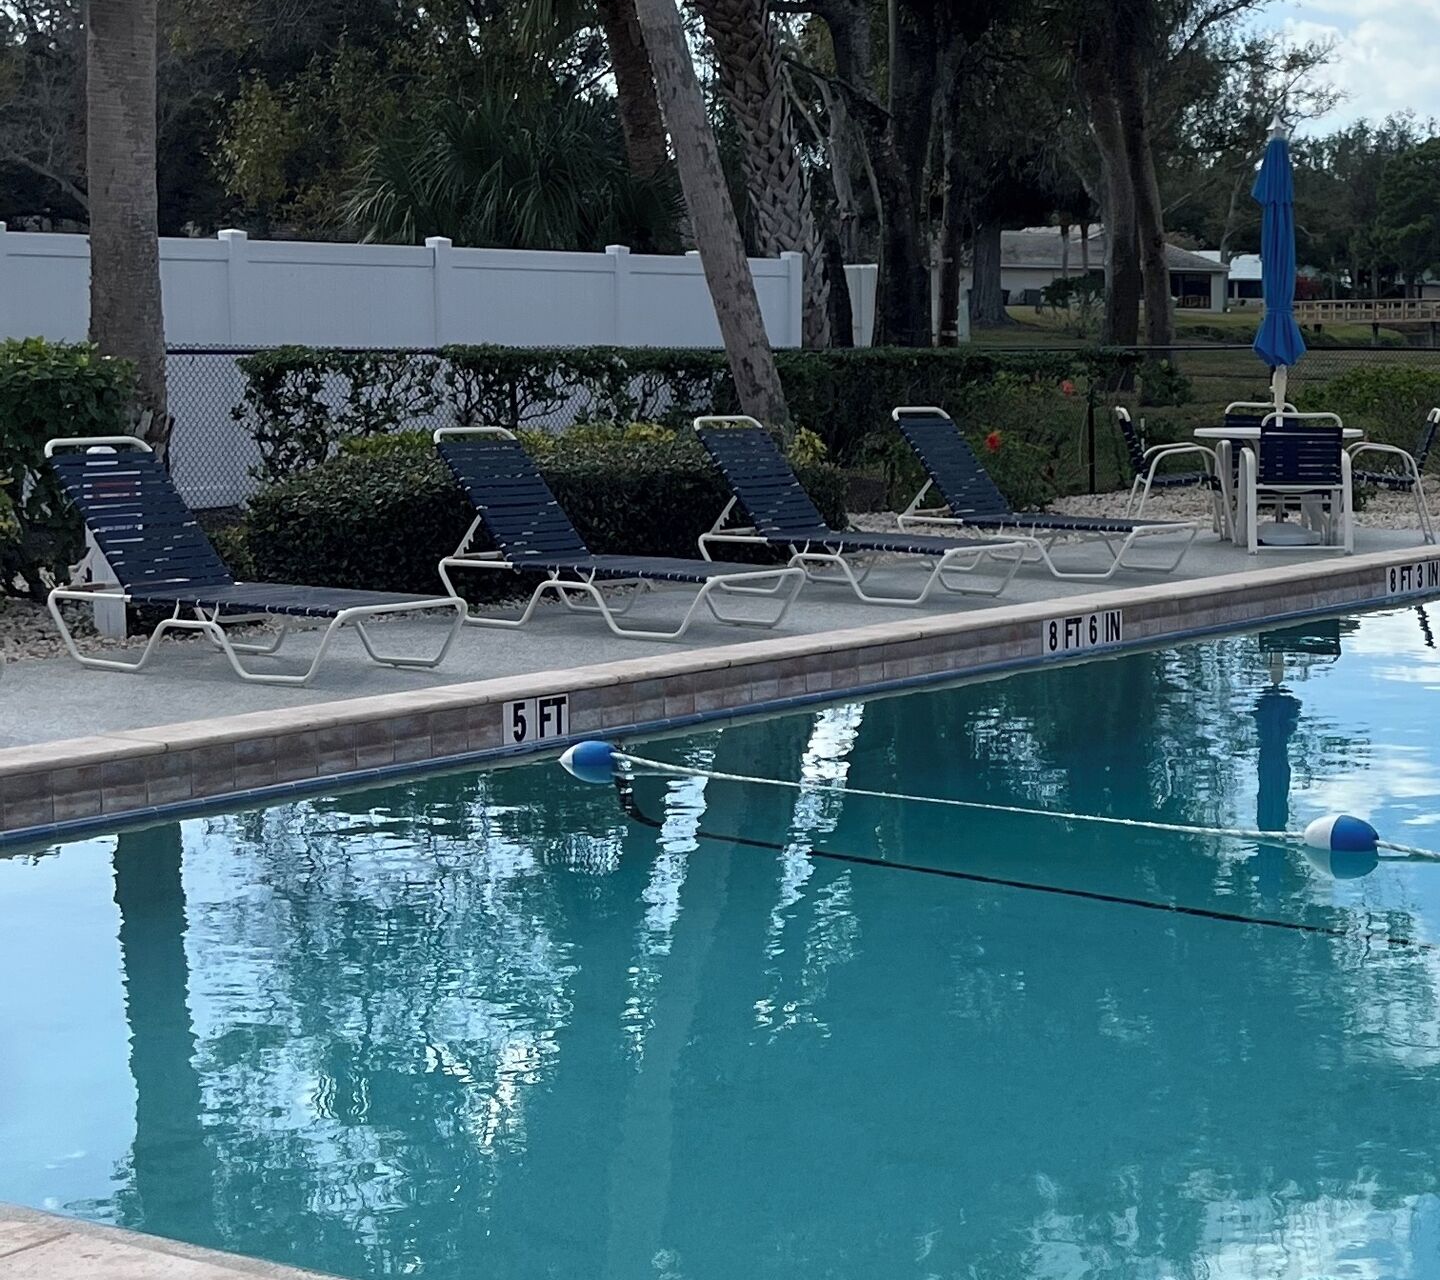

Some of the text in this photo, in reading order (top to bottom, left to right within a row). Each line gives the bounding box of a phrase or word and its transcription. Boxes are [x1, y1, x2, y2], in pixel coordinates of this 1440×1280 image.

[1390, 562, 1439, 592] 8 FT 3 IN
[1049, 611, 1121, 651] 8 FT 6 IN
[513, 696, 567, 743] 5 FT
